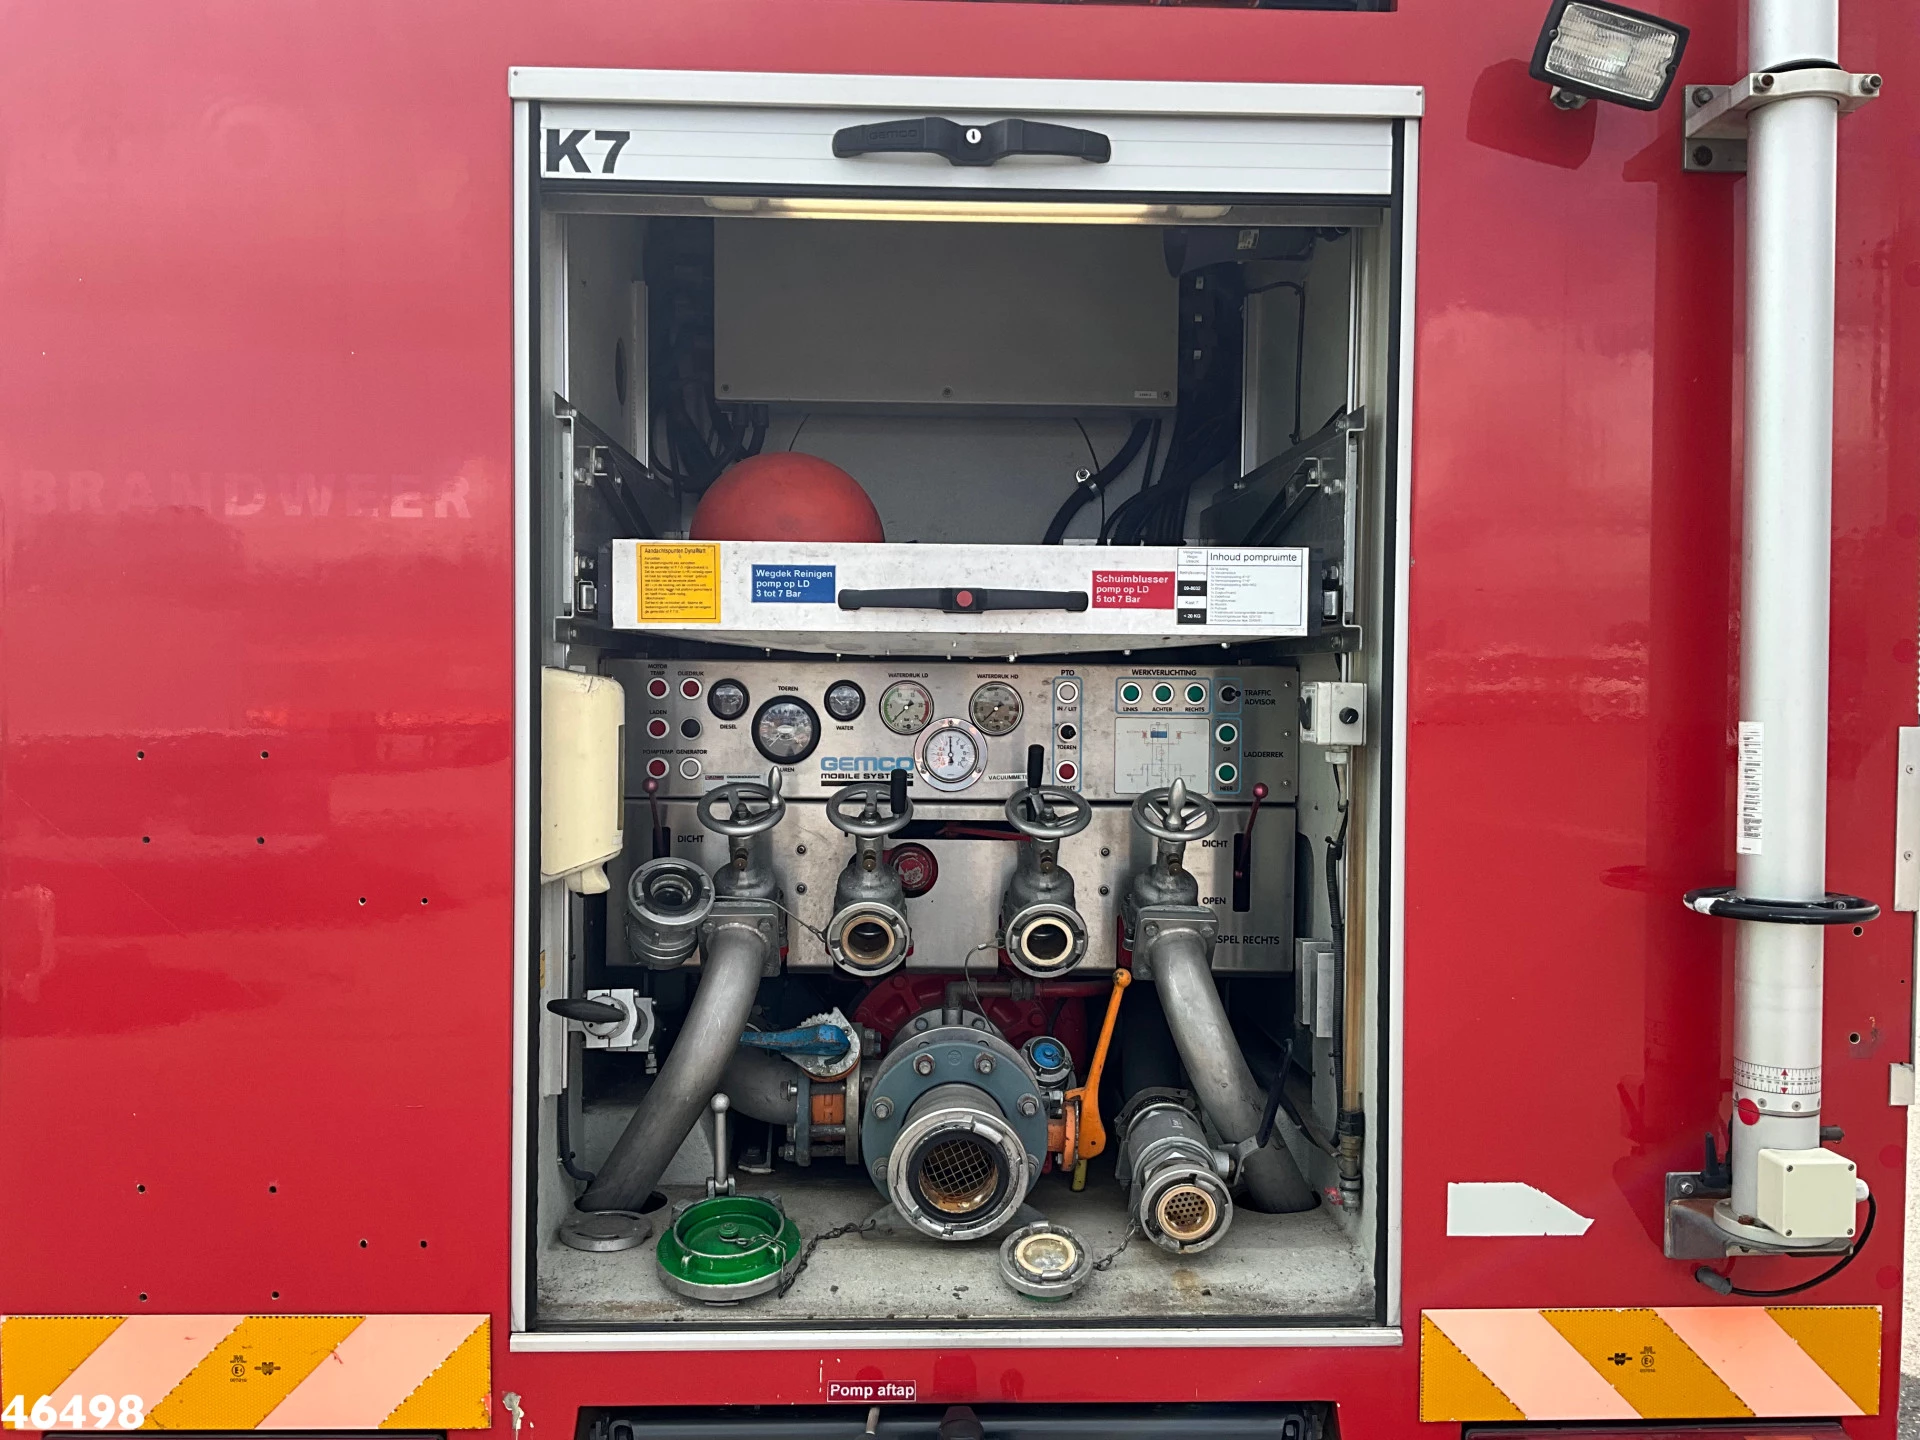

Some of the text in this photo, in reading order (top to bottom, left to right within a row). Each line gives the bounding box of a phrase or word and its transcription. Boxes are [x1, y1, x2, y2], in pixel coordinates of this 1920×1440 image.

[546, 128, 630, 173] K7
[1210, 552, 1241, 562] Inhoud
[1243, 552, 1297, 563] pompruimte
[756, 569, 833, 580] Wegdek Reinigen
[1096, 574, 1168, 584] Schuimblusser
[756, 579, 810, 589] pomp op LD
[756, 589, 802, 598] 3 tot 7 Bar
[1096, 585, 1150, 595] pomp op LD
[1096, 595, 1102, 603] 5
[1117, 595, 1123, 603] 7
[1125, 595, 1141, 603] Bar
[1131, 668, 1197, 676] WERKVERLICHTING
[821, 757, 914, 771] GEMCO
[677, 835, 704, 843] DICHT
[1202, 840, 1228, 848] DICHT
[1202, 897, 1227, 905] OPEN
[1216, 935, 1280, 944] SPEL RECHTS
[830, 1384, 915, 1399] Pomp aftap
